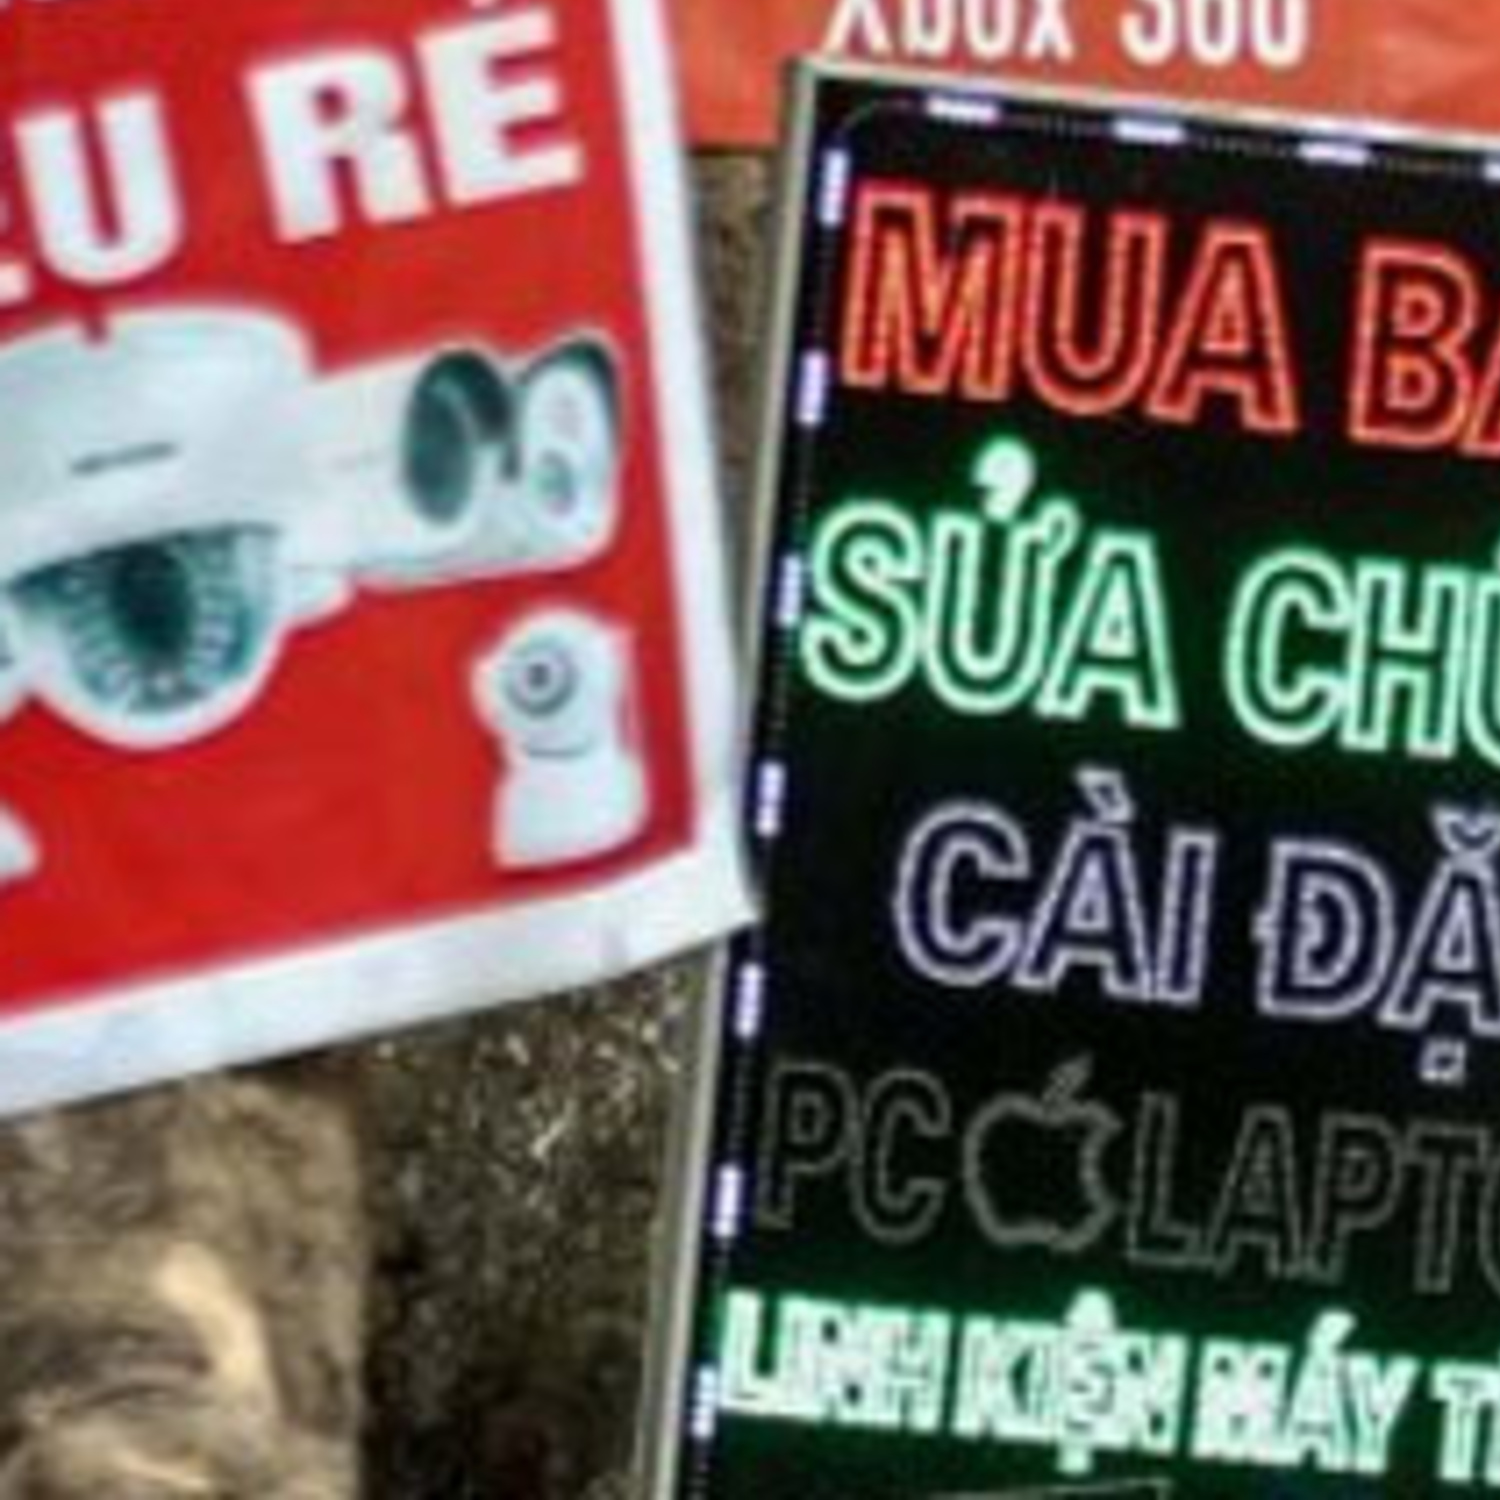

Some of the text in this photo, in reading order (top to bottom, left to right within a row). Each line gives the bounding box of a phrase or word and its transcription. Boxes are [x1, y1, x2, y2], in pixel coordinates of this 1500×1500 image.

[840, 180, 1299, 435] MUA
[802, 437, 1181, 730] SỬA
[893, 765, 1219, 1006] CÀI
[755, 1057, 953, 1244] PC
[718, 1290, 950, 1435] LINH
[1191, 1311, 1416, 1474] MÁY
